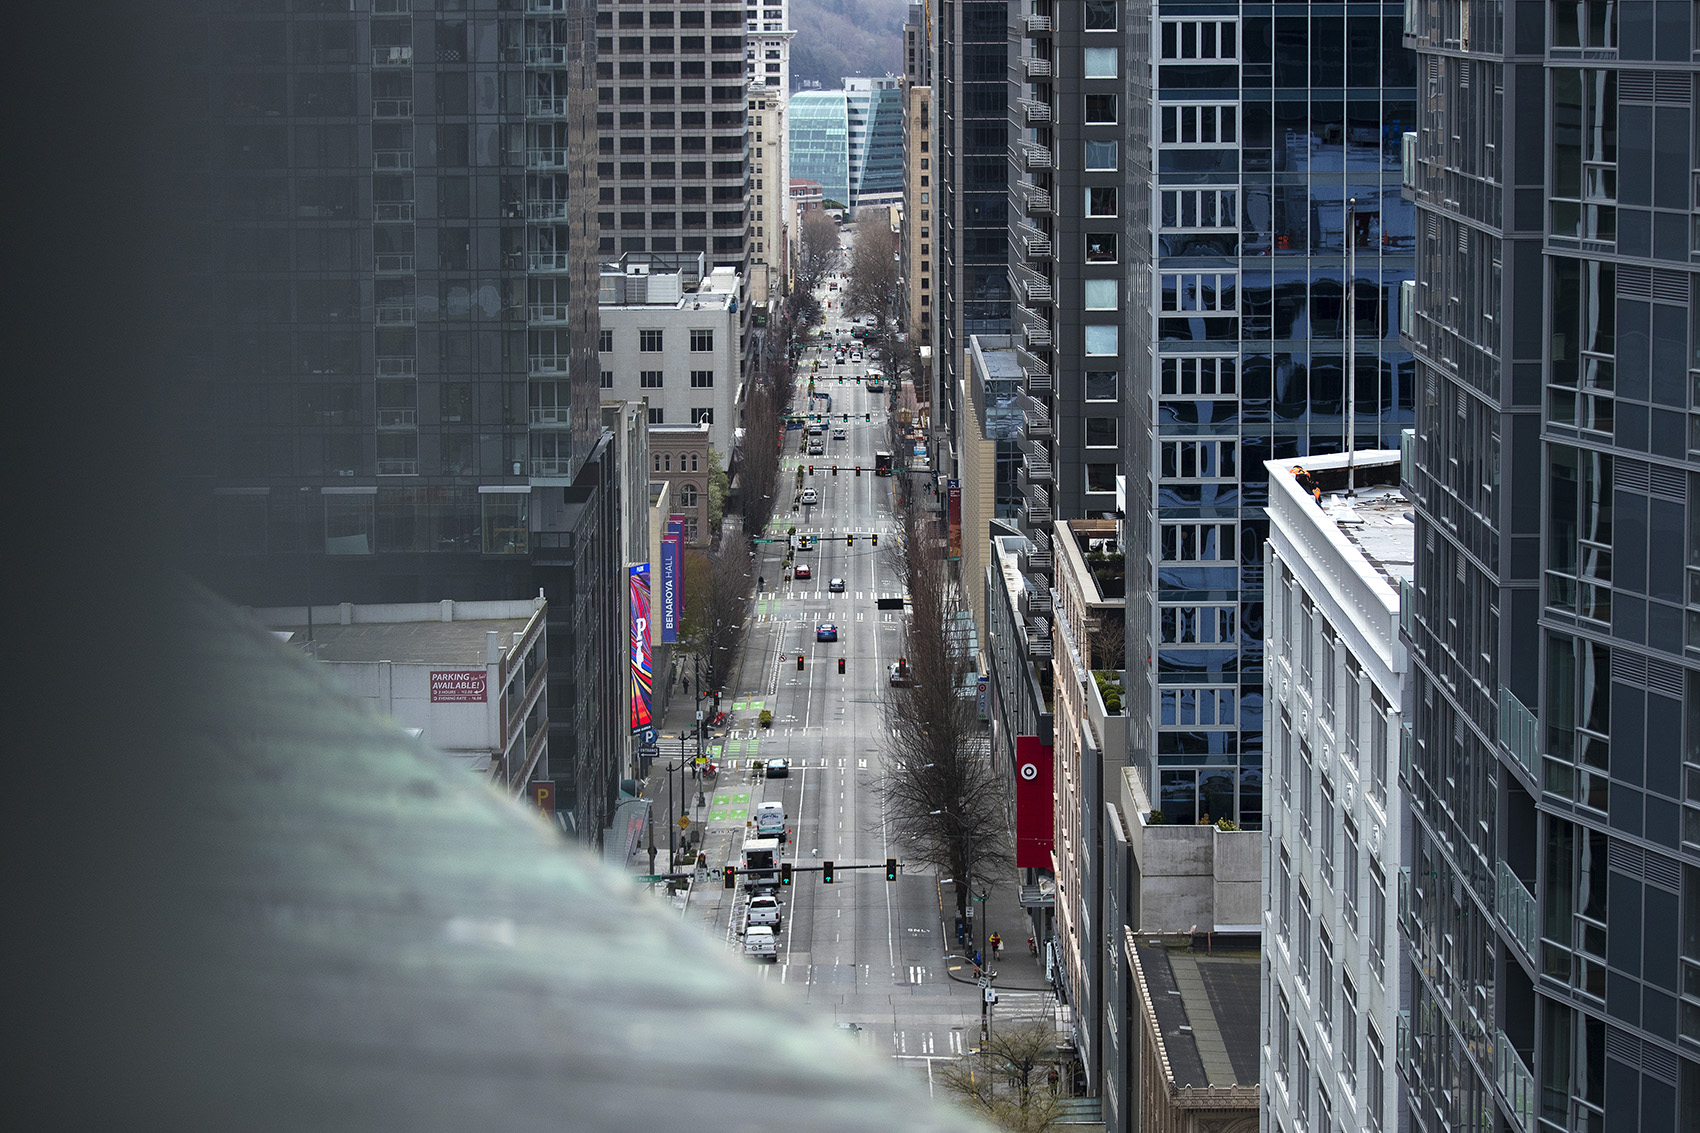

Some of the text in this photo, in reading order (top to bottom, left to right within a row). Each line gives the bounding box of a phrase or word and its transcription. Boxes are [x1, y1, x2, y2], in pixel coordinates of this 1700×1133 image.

[665, 556, 674, 629] BENAROYA HALL
[432, 681, 480, 689] AVAILABLE!
[645, 730, 654, 743] P
[537, 788, 550, 807] P
